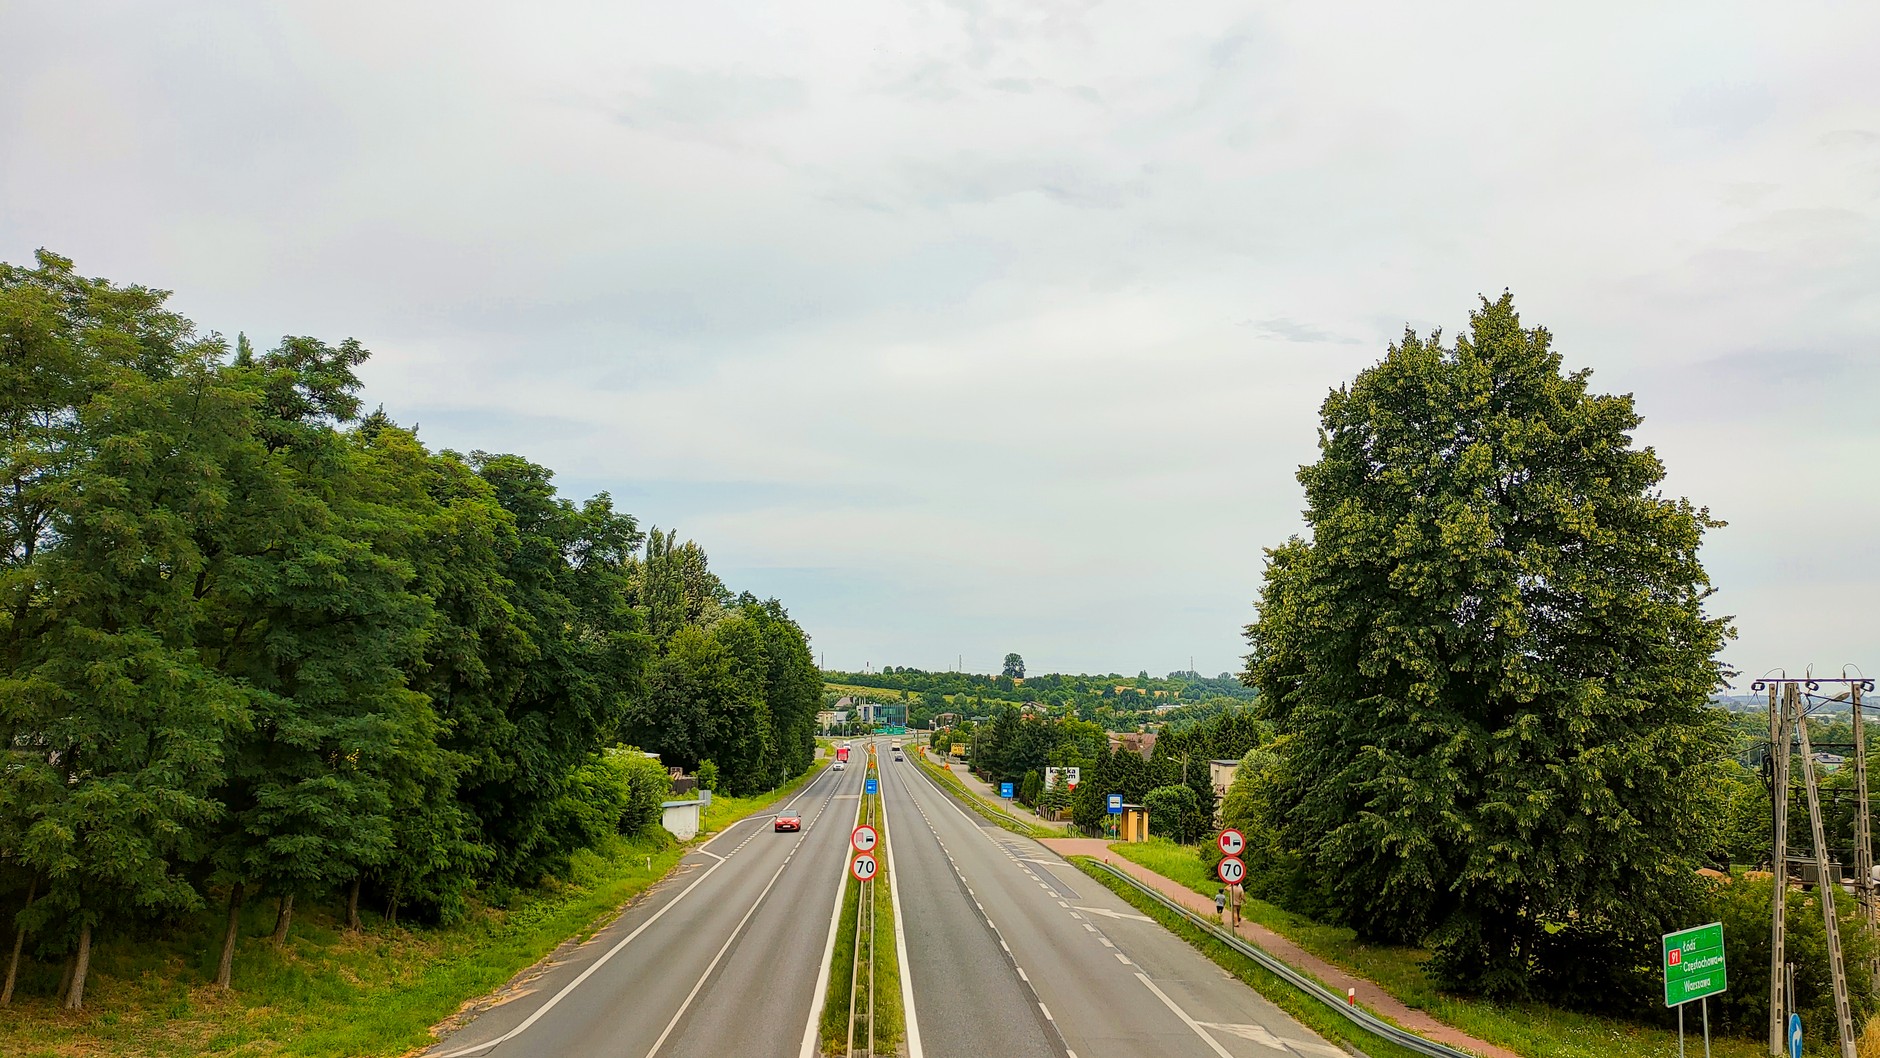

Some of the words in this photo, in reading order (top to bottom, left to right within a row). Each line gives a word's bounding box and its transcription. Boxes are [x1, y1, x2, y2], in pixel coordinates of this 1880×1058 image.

[856, 860, 874, 874] 70
[1223, 864, 1242, 877] 70
[1682, 937, 1697, 952] Łódź
[1671, 951, 1679, 964] 91
[1683, 955, 1719, 973] Częstochowa
[1684, 978, 1711, 992] Warszawa
